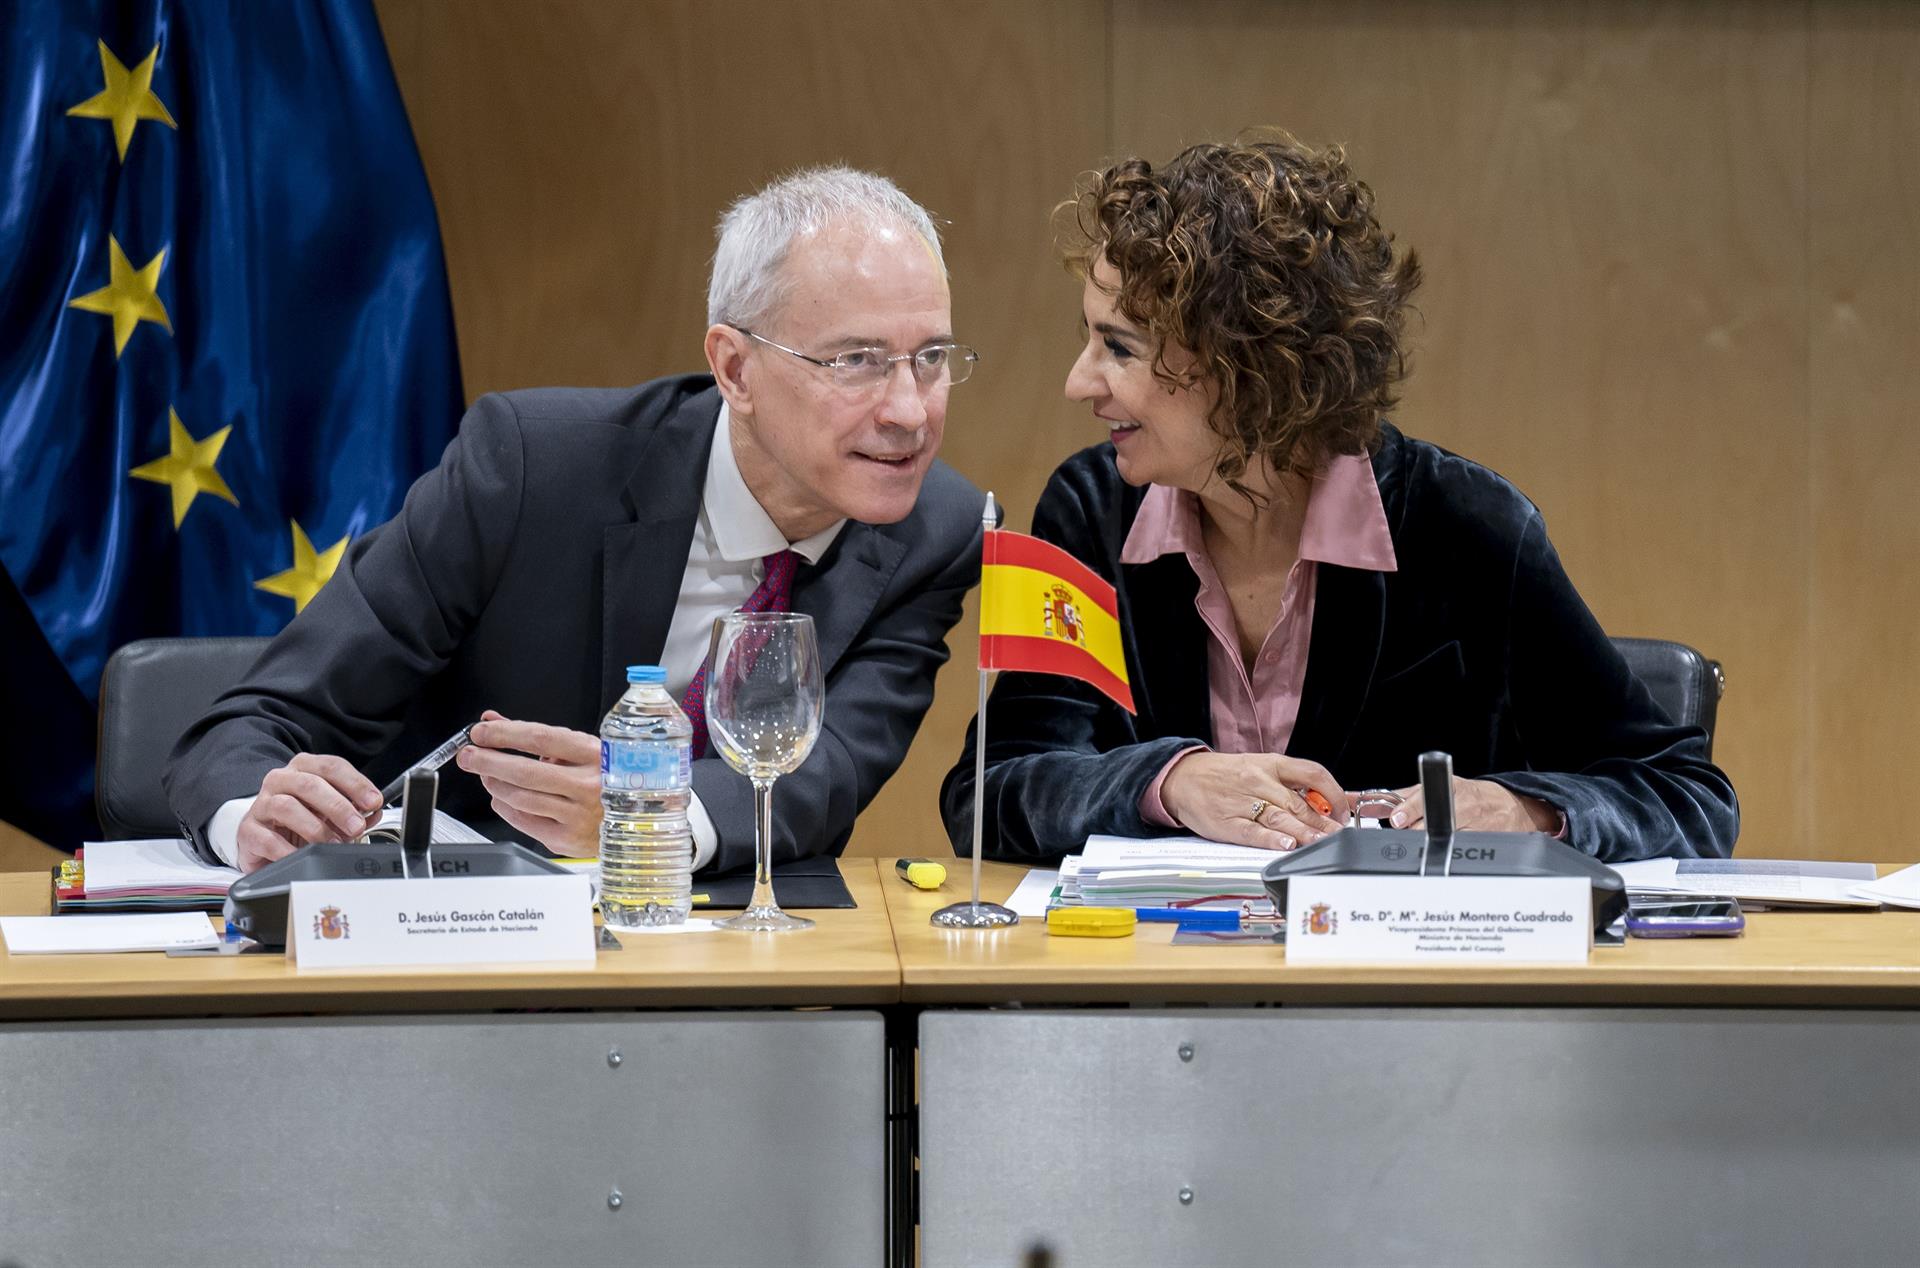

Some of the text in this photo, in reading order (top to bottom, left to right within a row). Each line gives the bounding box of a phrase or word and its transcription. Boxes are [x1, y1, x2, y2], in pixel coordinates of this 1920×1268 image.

[1419, 847, 1496, 860] SCH
[392, 861, 470, 873] BCH
[398, 908, 545, 923] D. Jesús Gascón Catalán
[1350, 911, 1374, 922] Sra.
[1423, 911, 1455, 922] Jesús
[1459, 911, 1510, 922] Montero
[1513, 911, 1573, 922] Cuadrado
[501, 924, 538, 932] Hacienda
